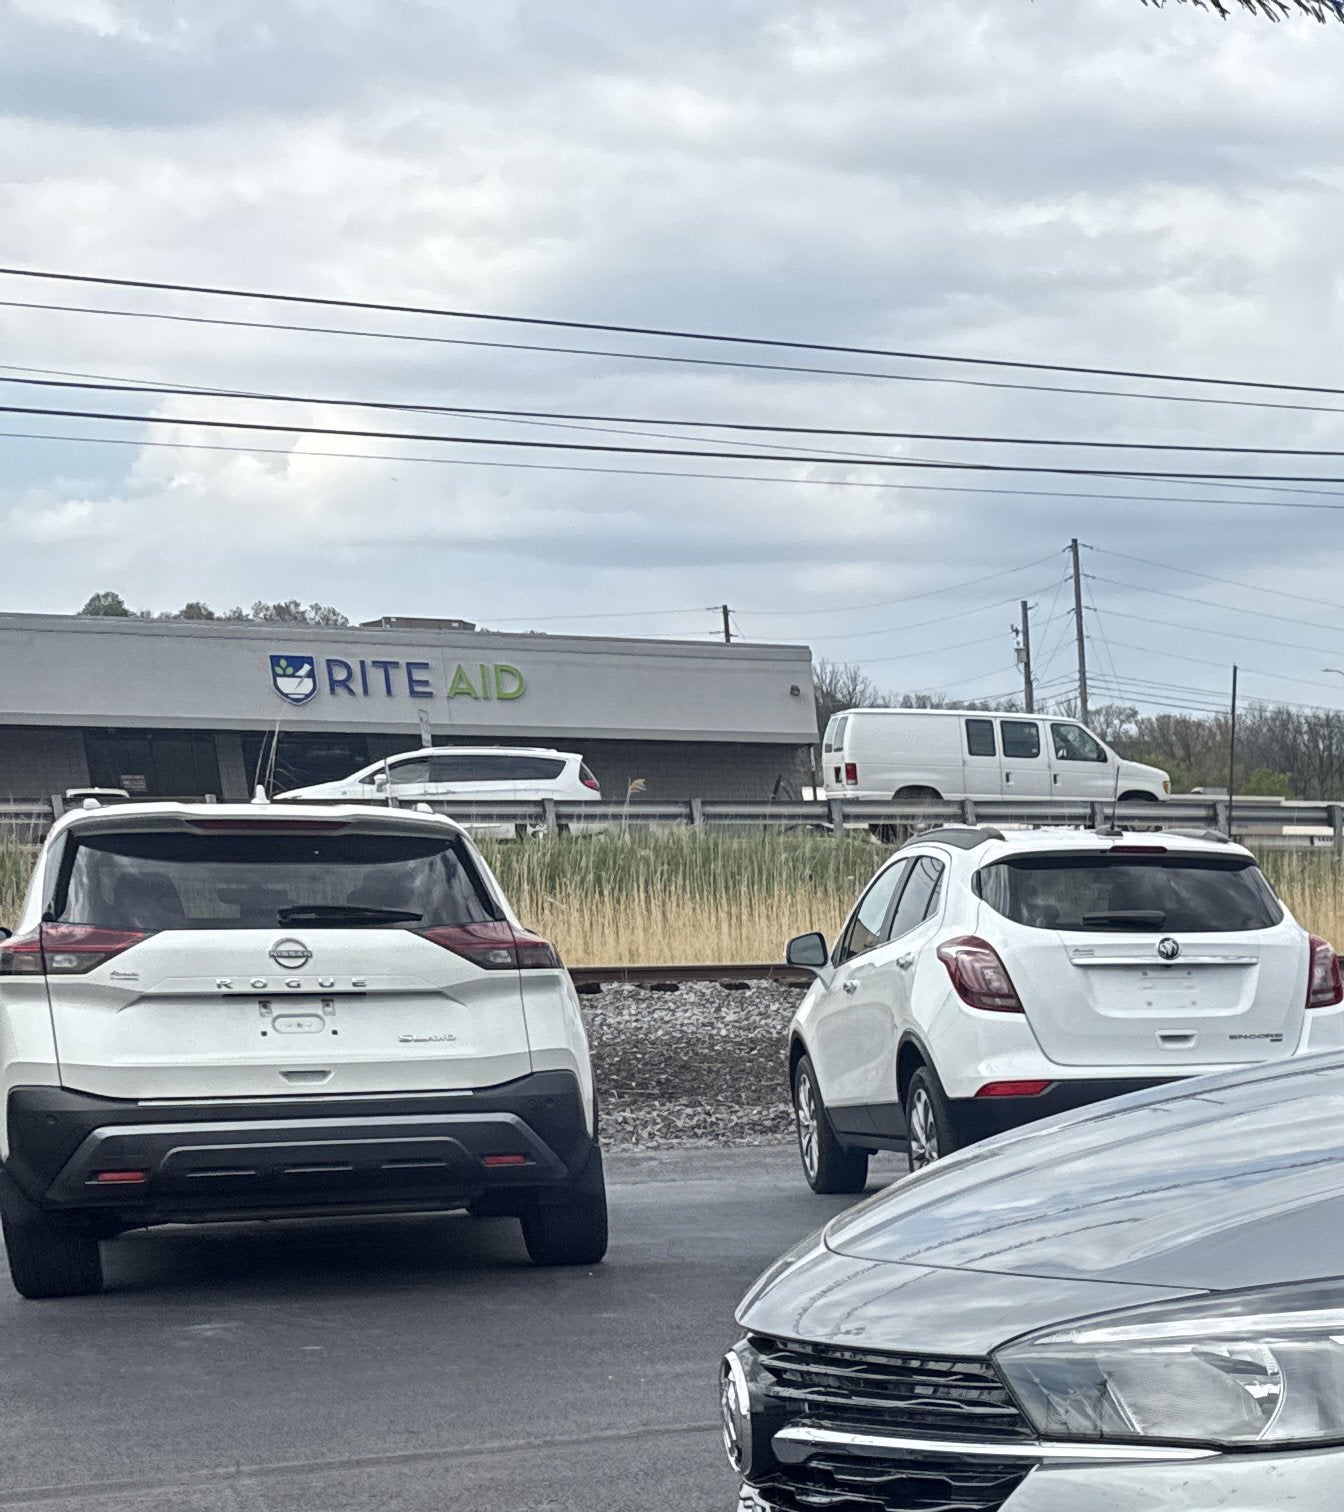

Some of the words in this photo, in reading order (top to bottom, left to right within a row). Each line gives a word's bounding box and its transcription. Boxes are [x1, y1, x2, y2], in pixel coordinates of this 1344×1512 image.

[325, 658, 434, 698] RITE
[447, 663, 527, 700] AID
[216, 978, 367, 989] ROGUE
